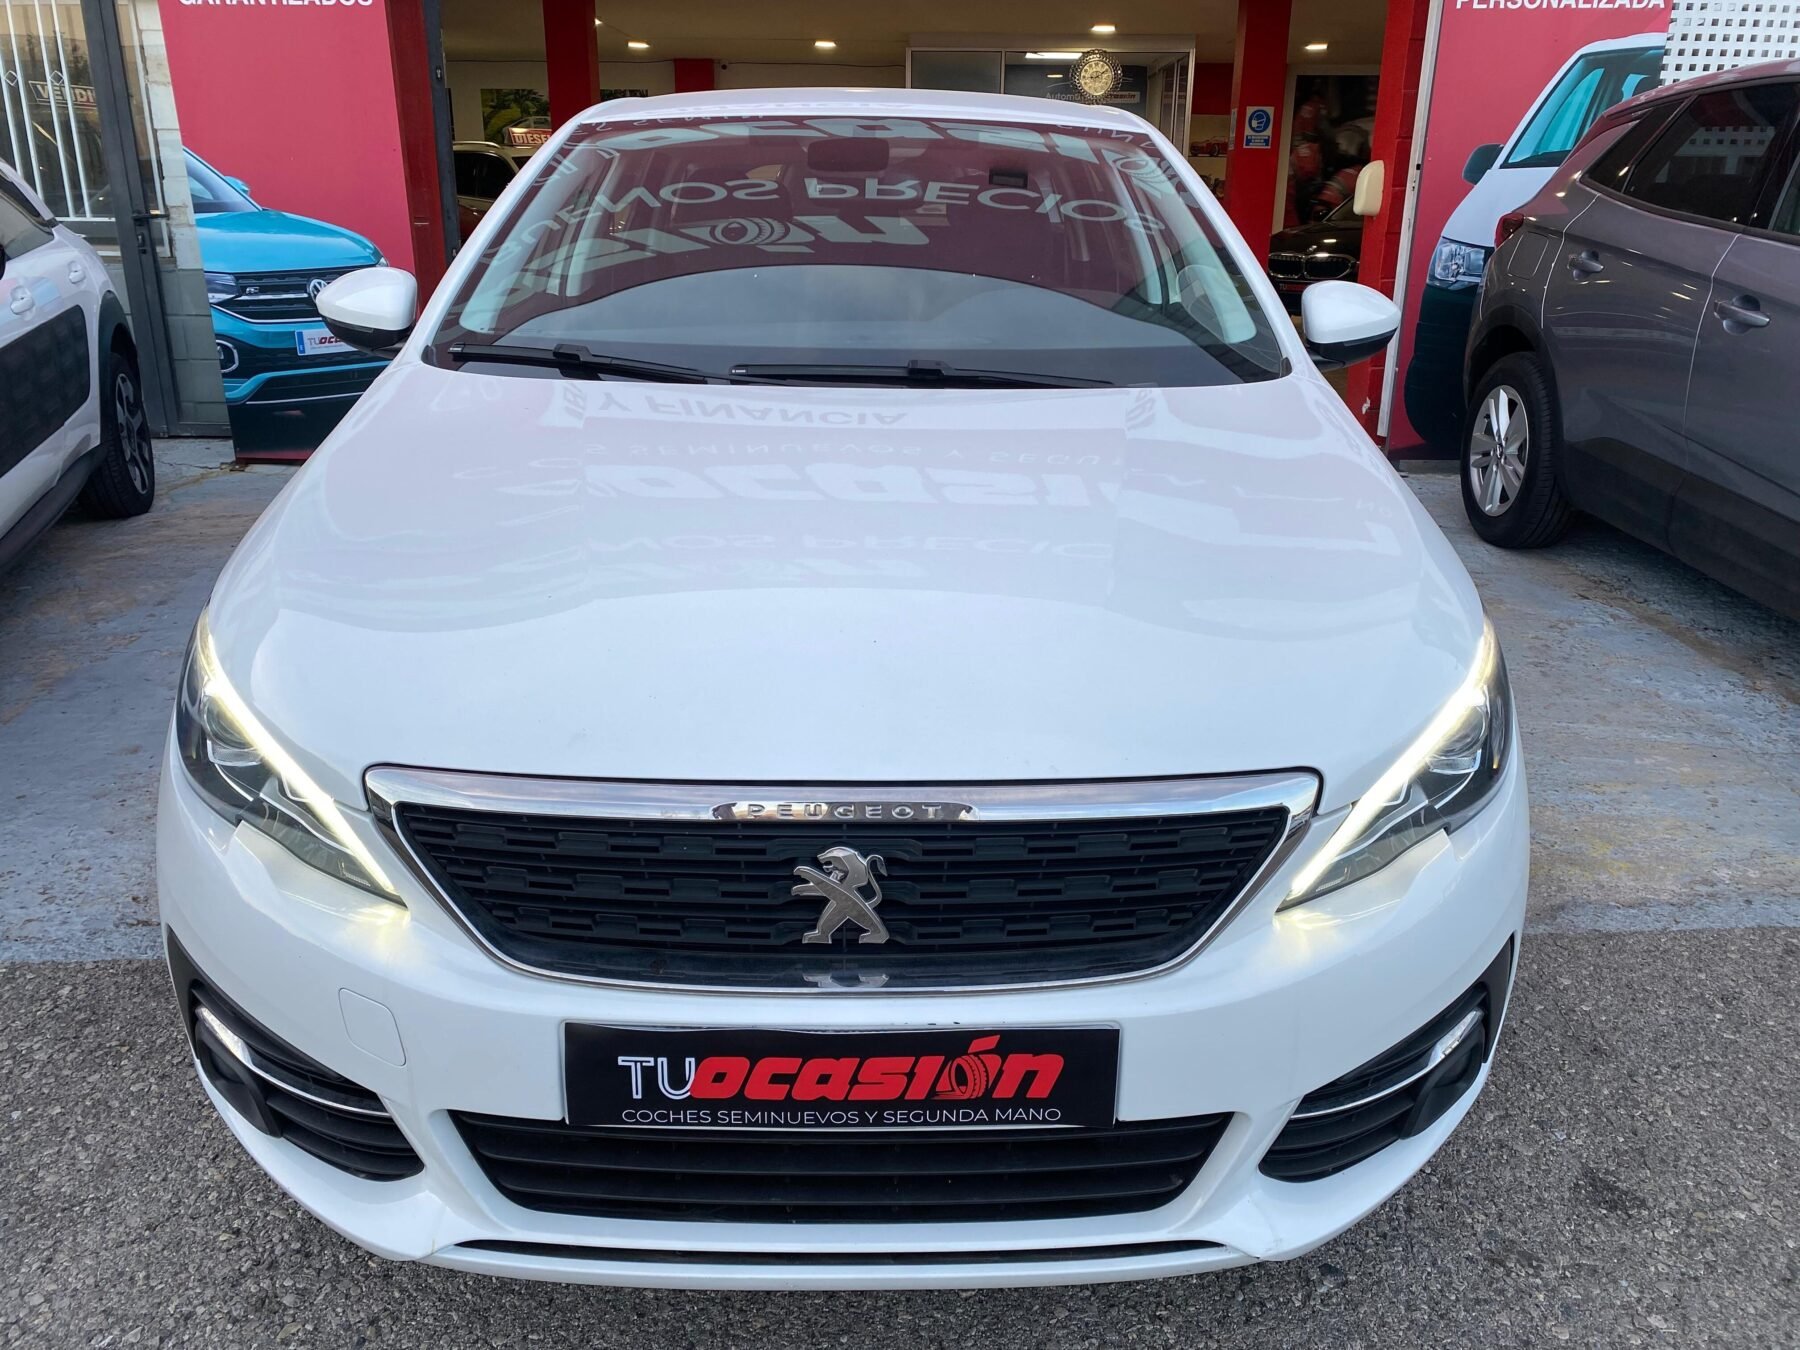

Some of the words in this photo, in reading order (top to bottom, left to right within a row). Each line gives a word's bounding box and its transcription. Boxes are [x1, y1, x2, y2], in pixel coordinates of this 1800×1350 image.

[36, 84, 96, 103] VENDI
[512, 133, 551, 144] DIESE
[747, 803, 941, 819] PEUGEOT
[621, 1109, 712, 1124] COCHES
[717, 1109, 860, 1125] SEMINUEVOS
[865, 1111, 879, 1124] Y
[883, 1109, 989, 1123] SEGUNDA
[994, 1108, 1062, 1122] MANO
